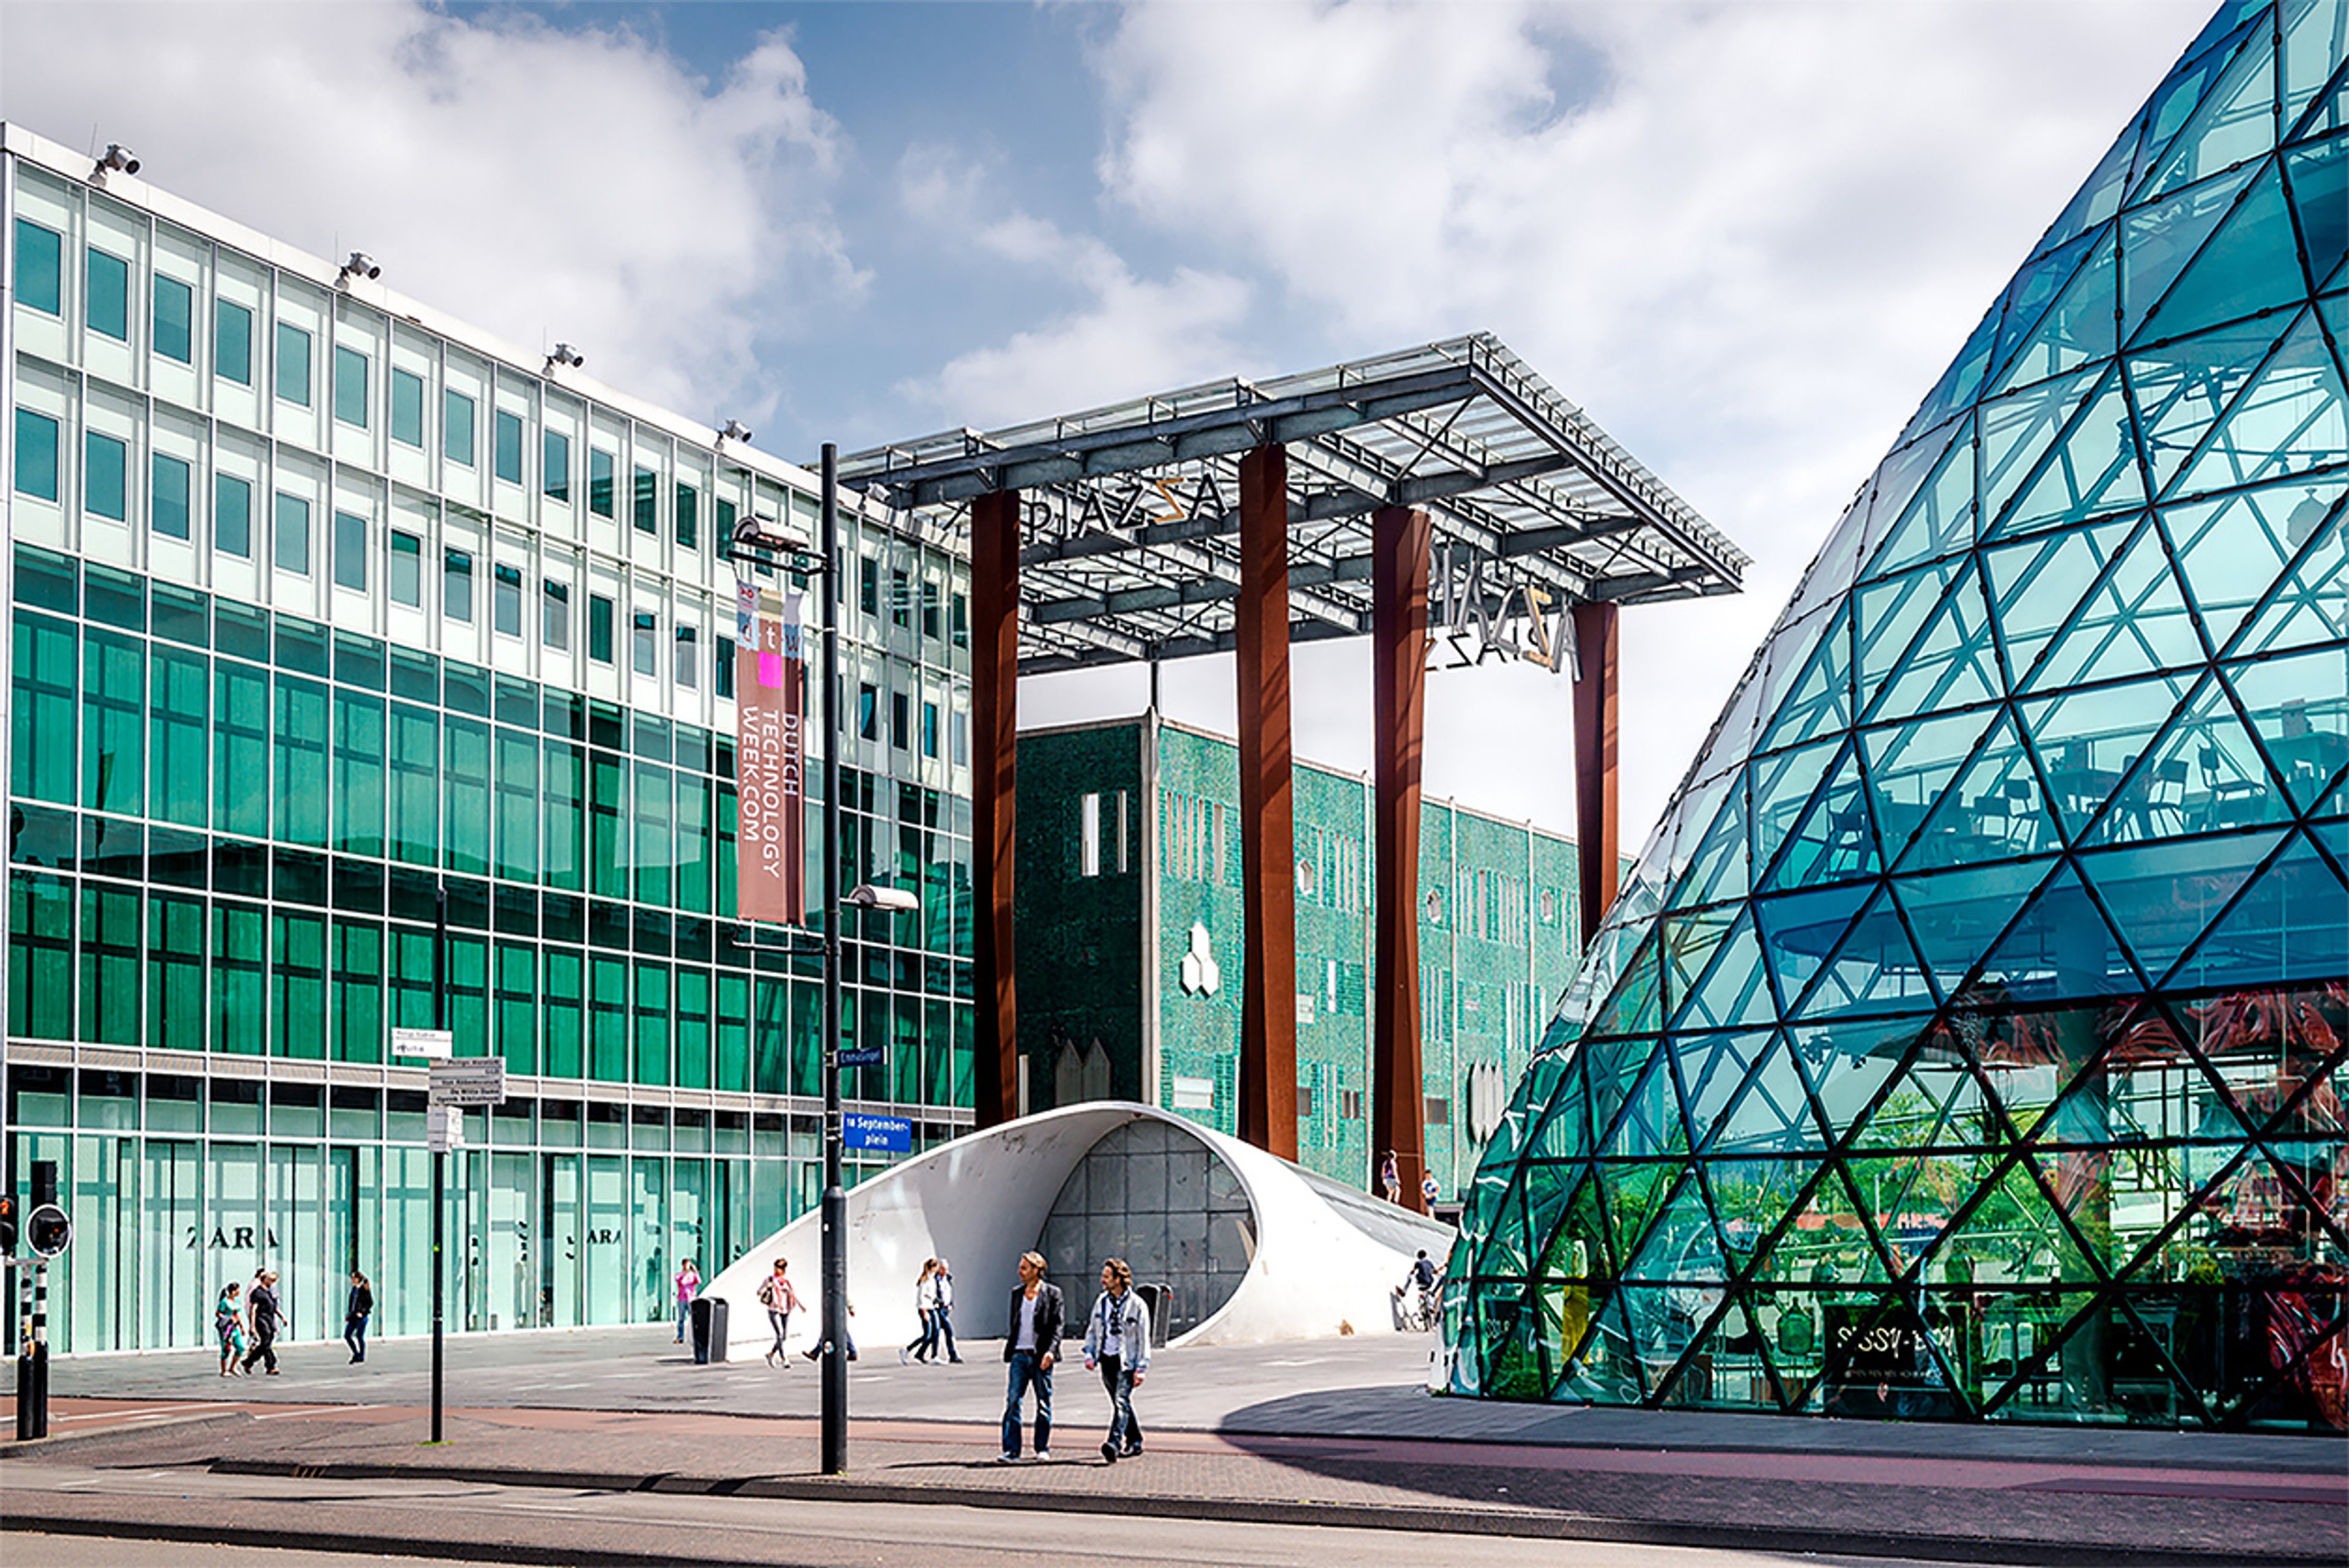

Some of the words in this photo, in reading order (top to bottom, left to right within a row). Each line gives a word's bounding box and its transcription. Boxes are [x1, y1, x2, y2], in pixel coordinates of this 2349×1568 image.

[1030, 474, 1229, 542] PIAZZA
[741, 706, 760, 841] WEEK.COM
[762, 710, 780, 878] TECHNOLOGY
[784, 713, 798, 795] DUTCH
